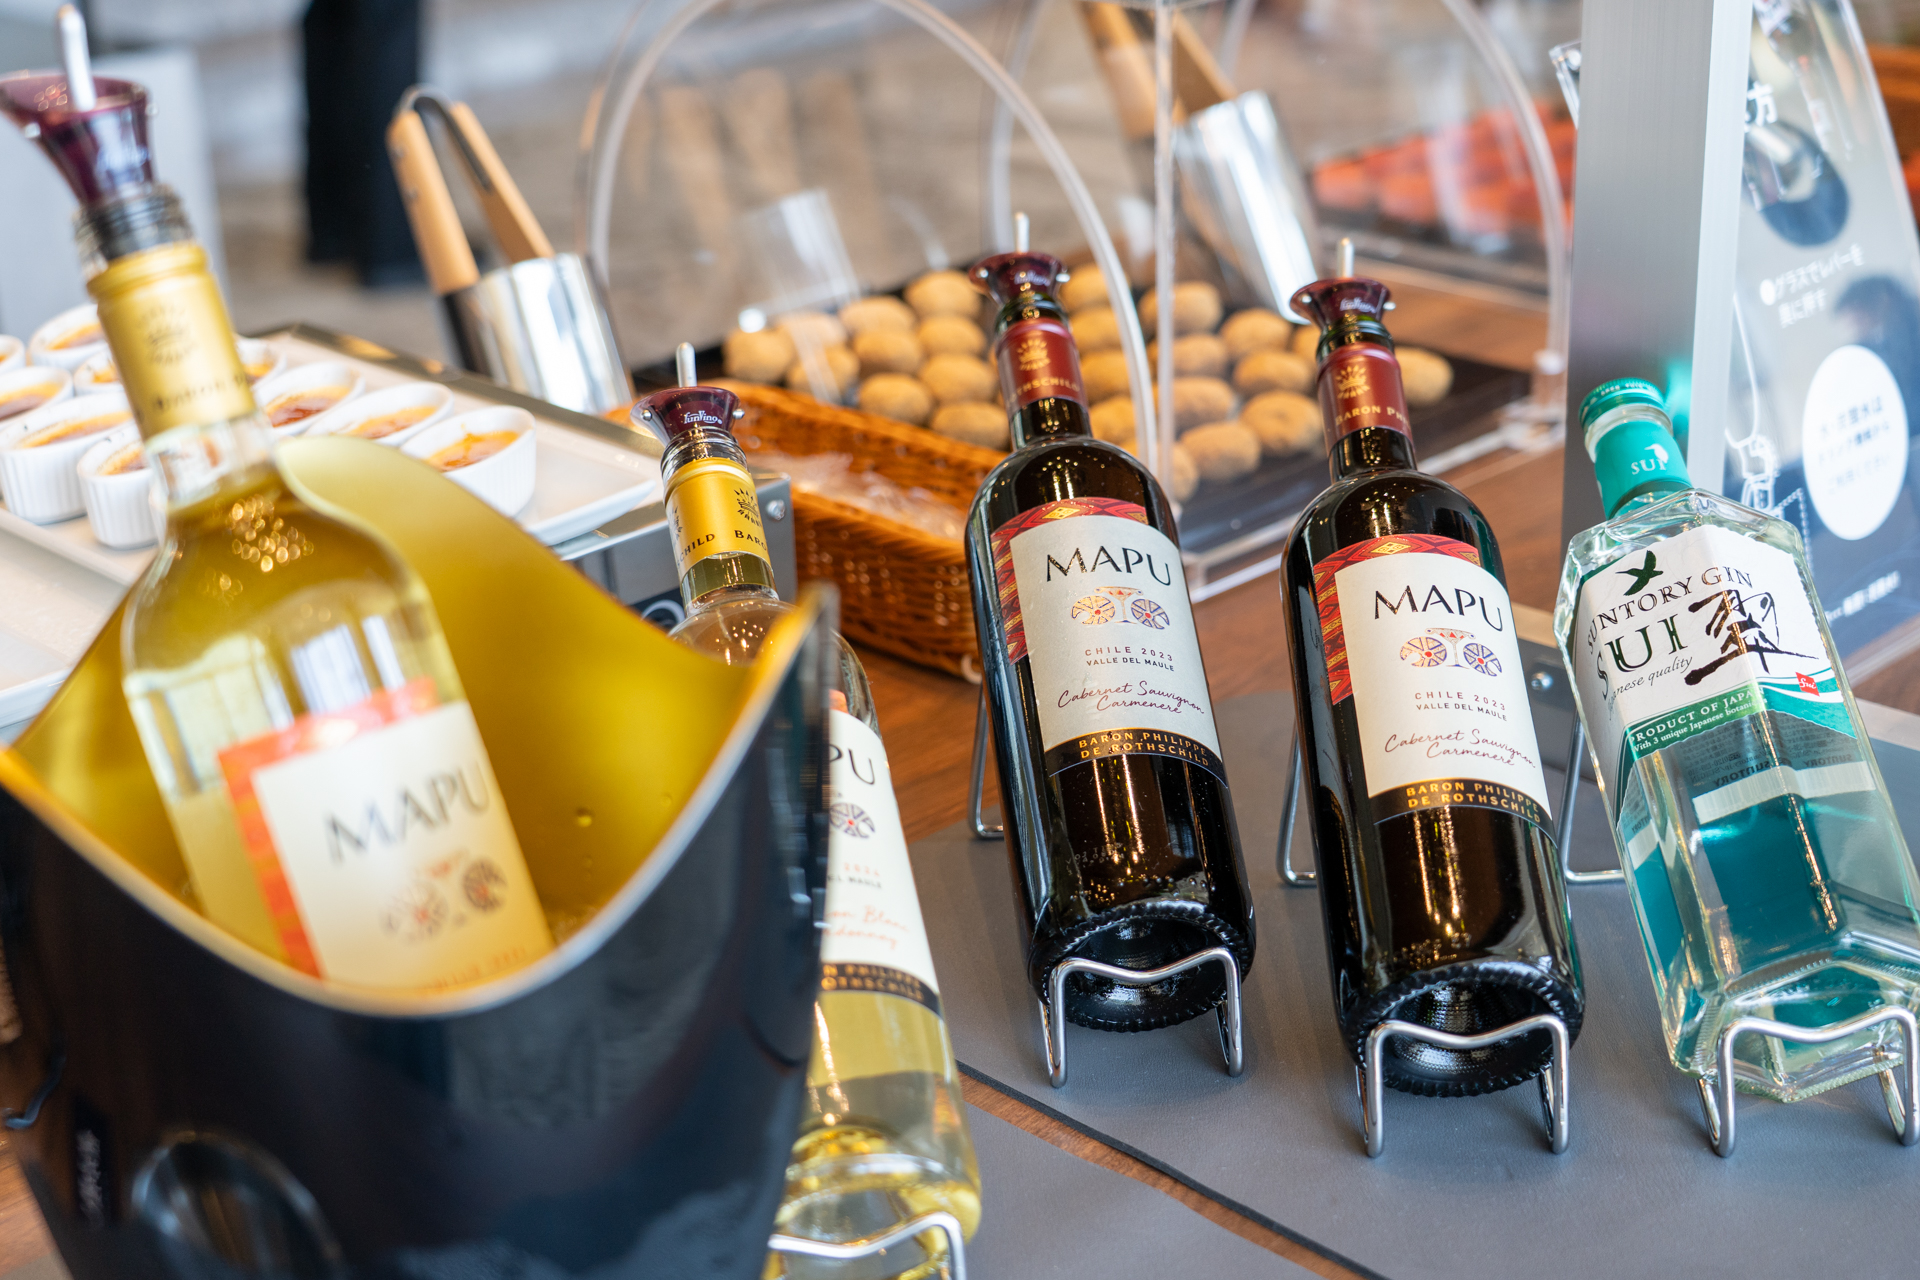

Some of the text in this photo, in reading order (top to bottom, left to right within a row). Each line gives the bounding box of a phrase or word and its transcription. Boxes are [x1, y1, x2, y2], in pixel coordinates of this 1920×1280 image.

[1335, 405, 1381, 427] BARON
[1630, 458, 1667, 475] SUI
[1046, 545, 1171, 586] MAPU
[1374, 585, 1503, 632] MAPU
[1587, 566, 1753, 655] SUNTORY GIN
[1084, 646, 1173, 662] CHILE 2023
[1086, 657, 1175, 672] VALLE DEL MAULE
[1596, 613, 1689, 701] SUI
[1648, 656, 1693, 686] quality
[1057, 680, 1205, 714] Cabernet Sauvignon
[1096, 695, 1182, 714] Carmenere
[1414, 691, 1506, 711] CHILE 2023
[1416, 702, 1507, 721] VALLE DEL MAULE
[1629, 711, 1696, 746] PRODUCT
[1700, 702, 1719, 715] OF
[1723, 686, 1764, 708] JAPAN
[1653, 736, 1659, 744] 3
[1660, 728, 1688, 742] unique
[1689, 712, 1724, 732] Japanese
[1725, 698, 1768, 716] botanics
[1079, 732, 1207, 757] BARON PHILIPPE
[1080, 742, 1209, 766] DE ROTHSCHILD
[1384, 729, 1536, 769] Cabernet Sauvignon
[1426, 742, 1515, 766] Carmenere
[1406, 782, 1539, 812] BARON PHILIPPE
[1408, 793, 1541, 823] DE ROTHSCHILD
[325, 759, 492, 867] MAPU
